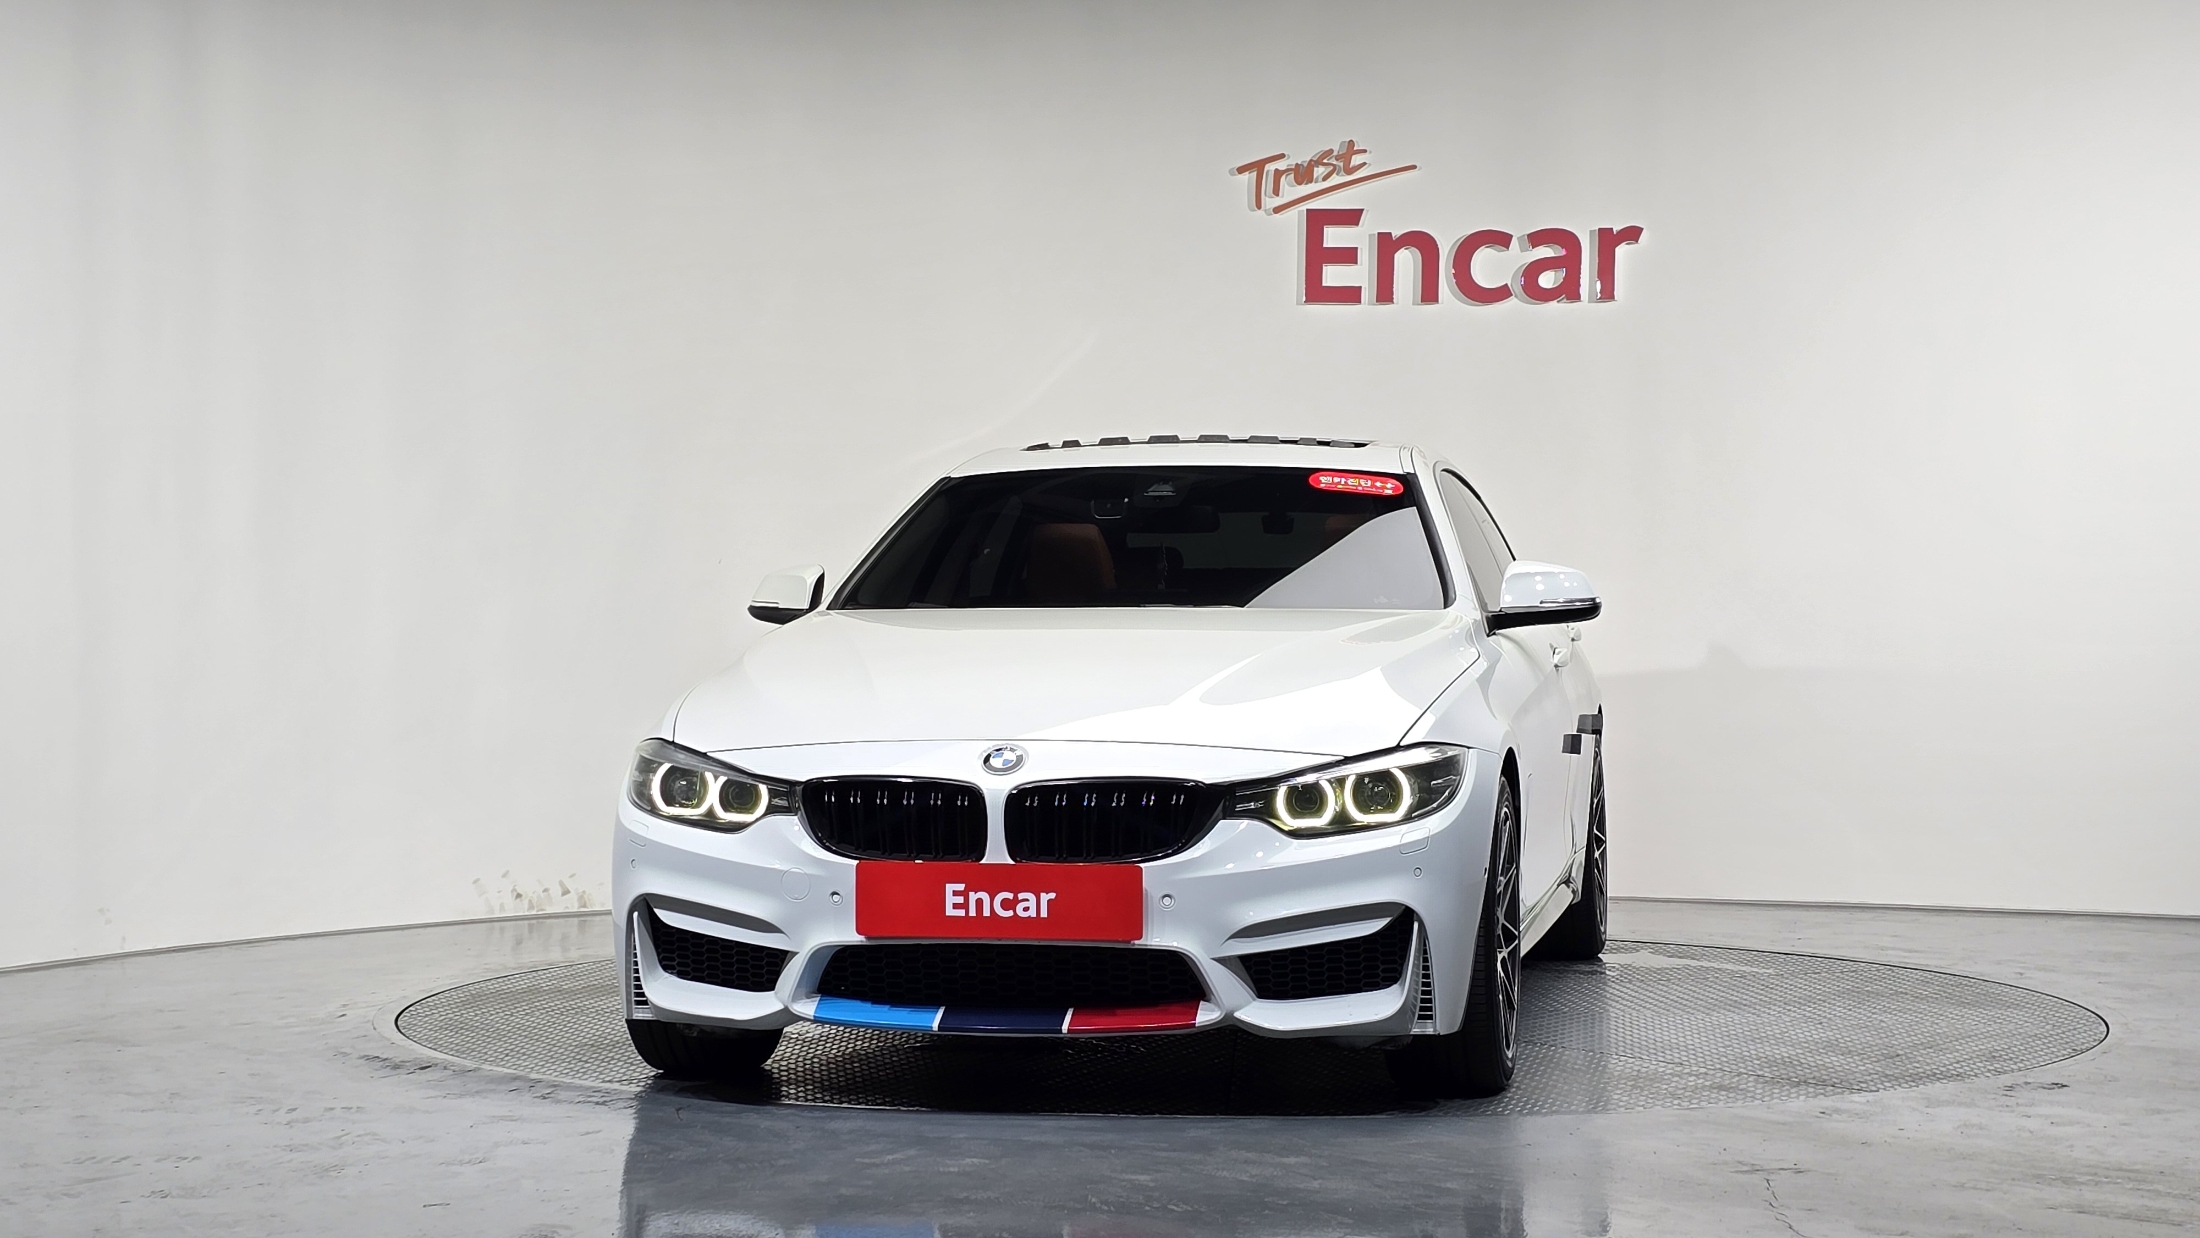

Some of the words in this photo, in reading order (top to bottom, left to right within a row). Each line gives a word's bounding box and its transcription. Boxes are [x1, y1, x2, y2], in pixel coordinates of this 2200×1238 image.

[1236, 139, 1368, 210] Trust
[1302, 208, 1644, 304] Encar
[945, 883, 1056, 918] Encar
